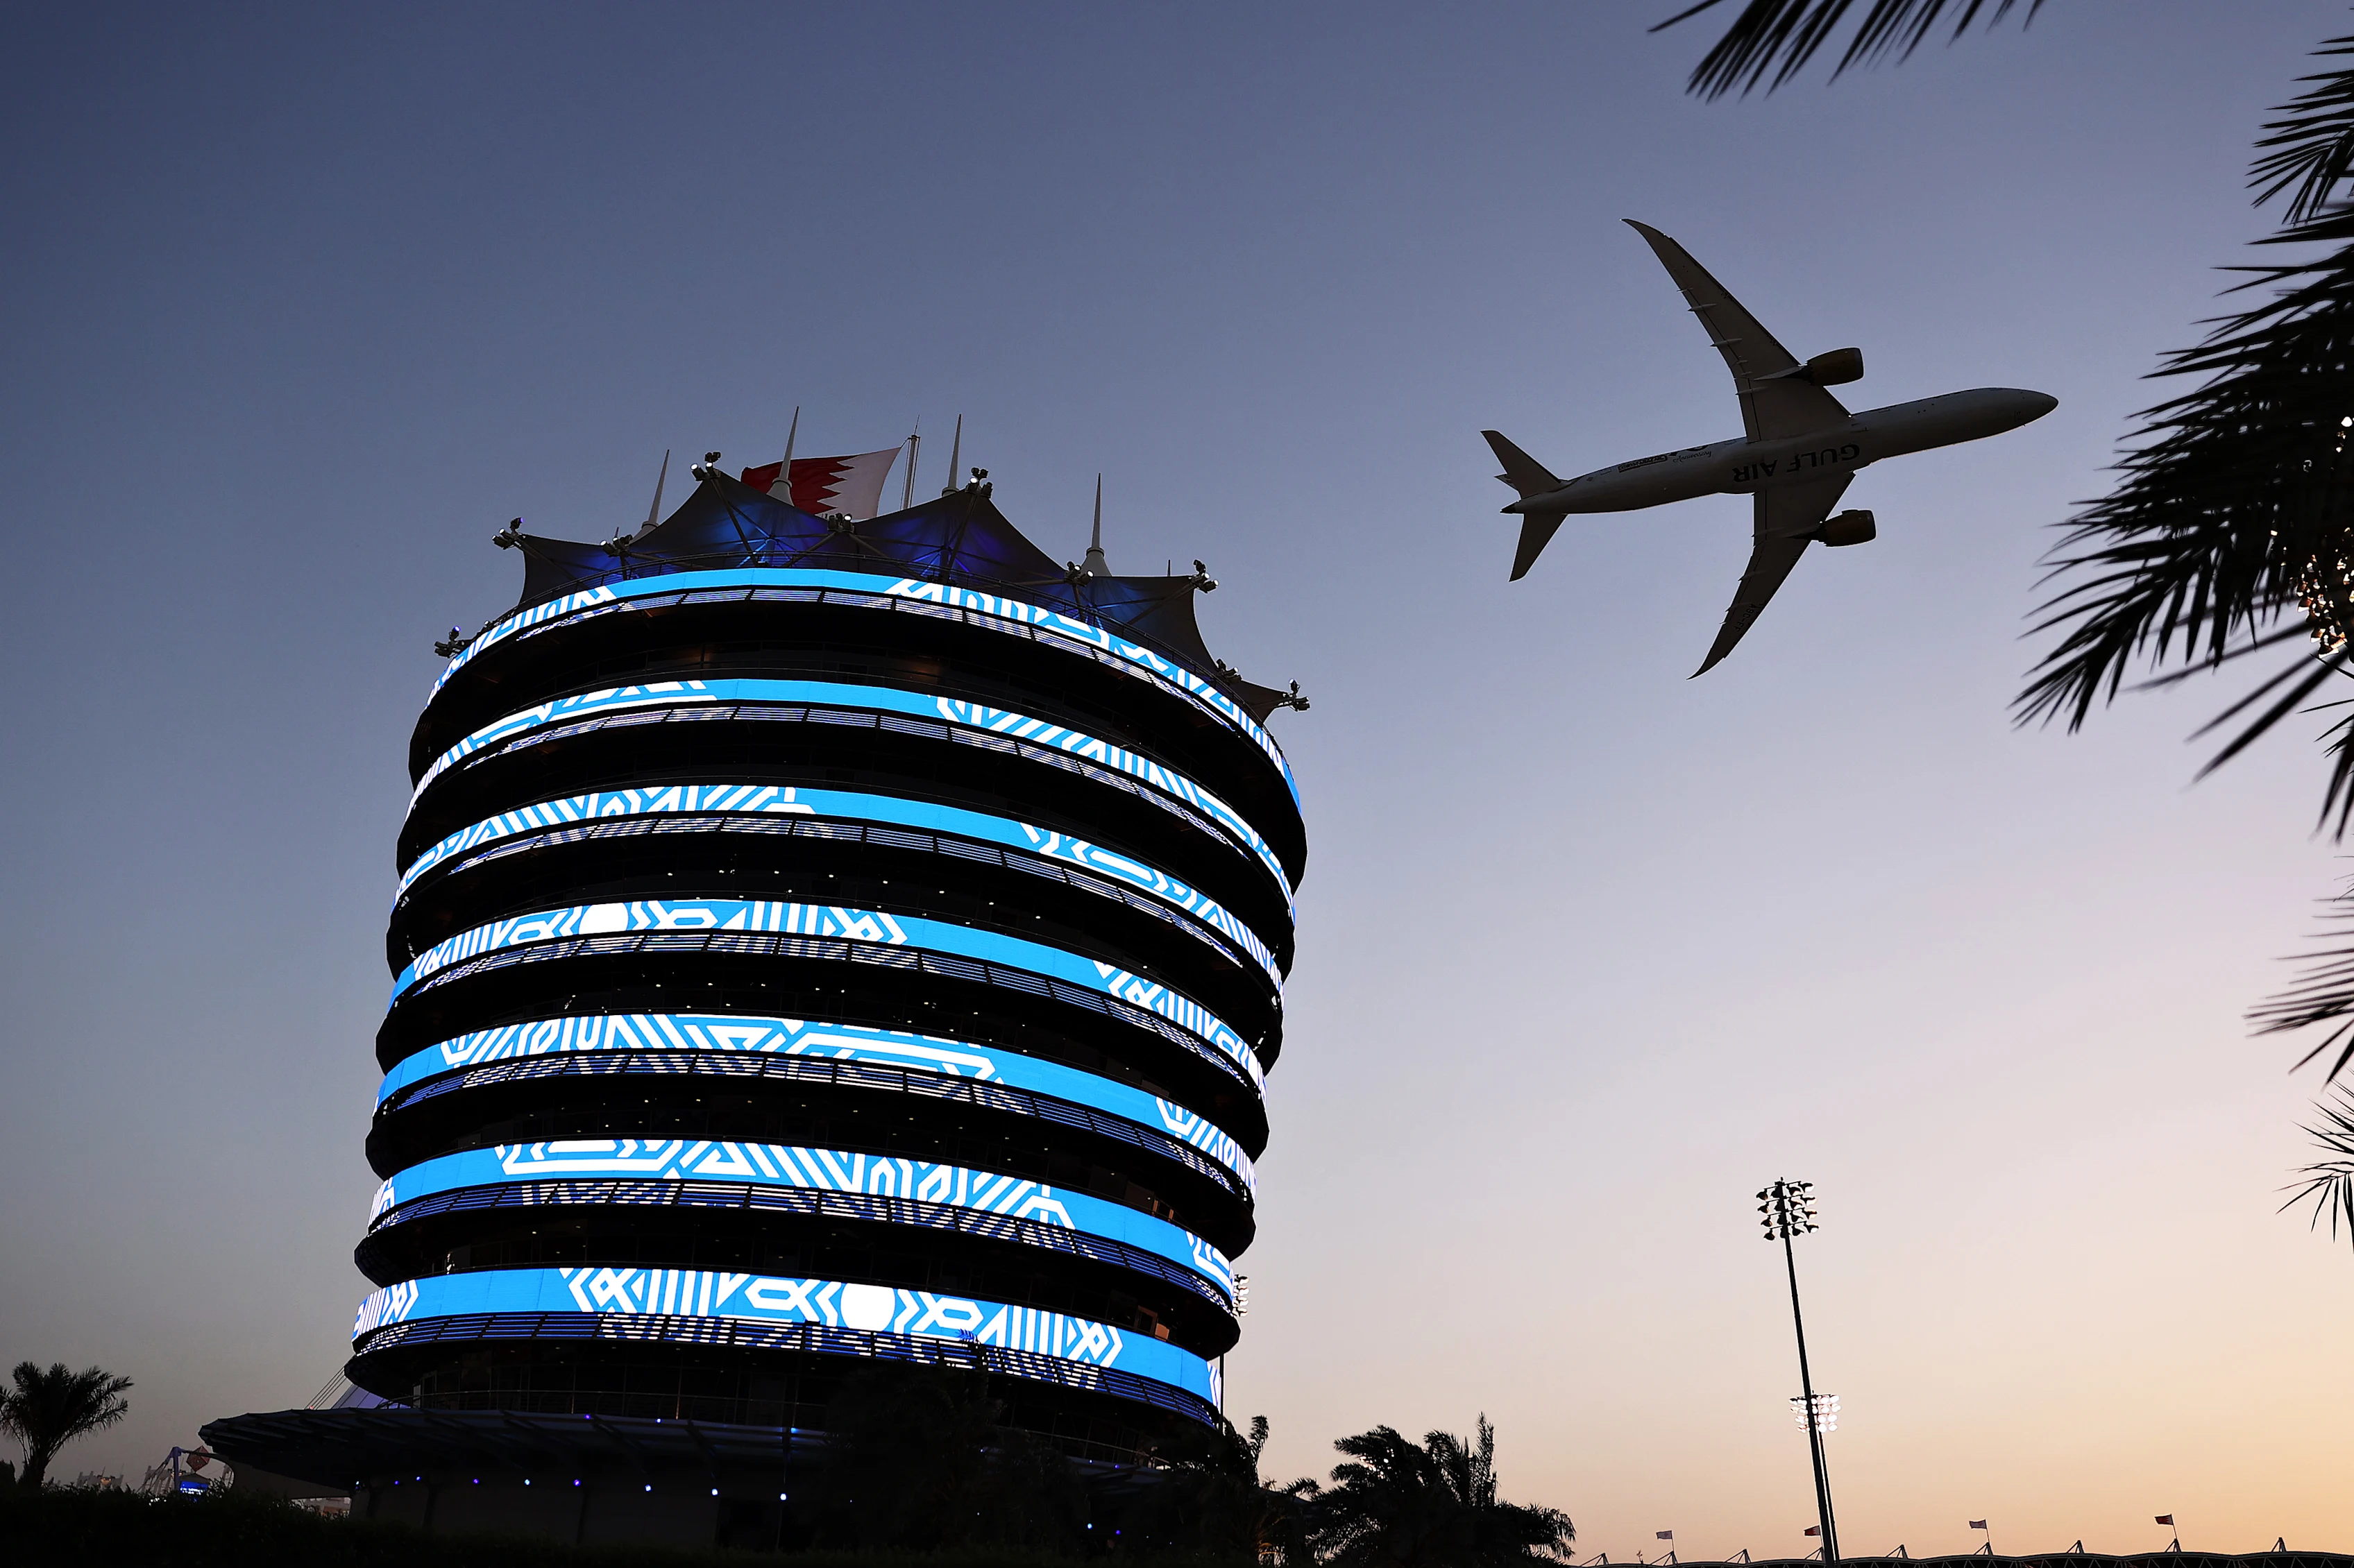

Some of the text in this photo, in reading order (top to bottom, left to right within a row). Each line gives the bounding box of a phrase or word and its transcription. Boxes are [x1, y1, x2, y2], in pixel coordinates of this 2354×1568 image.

[1673, 451, 1712, 463] Anniversary
[1731, 444, 1861, 483] GULF AIR
